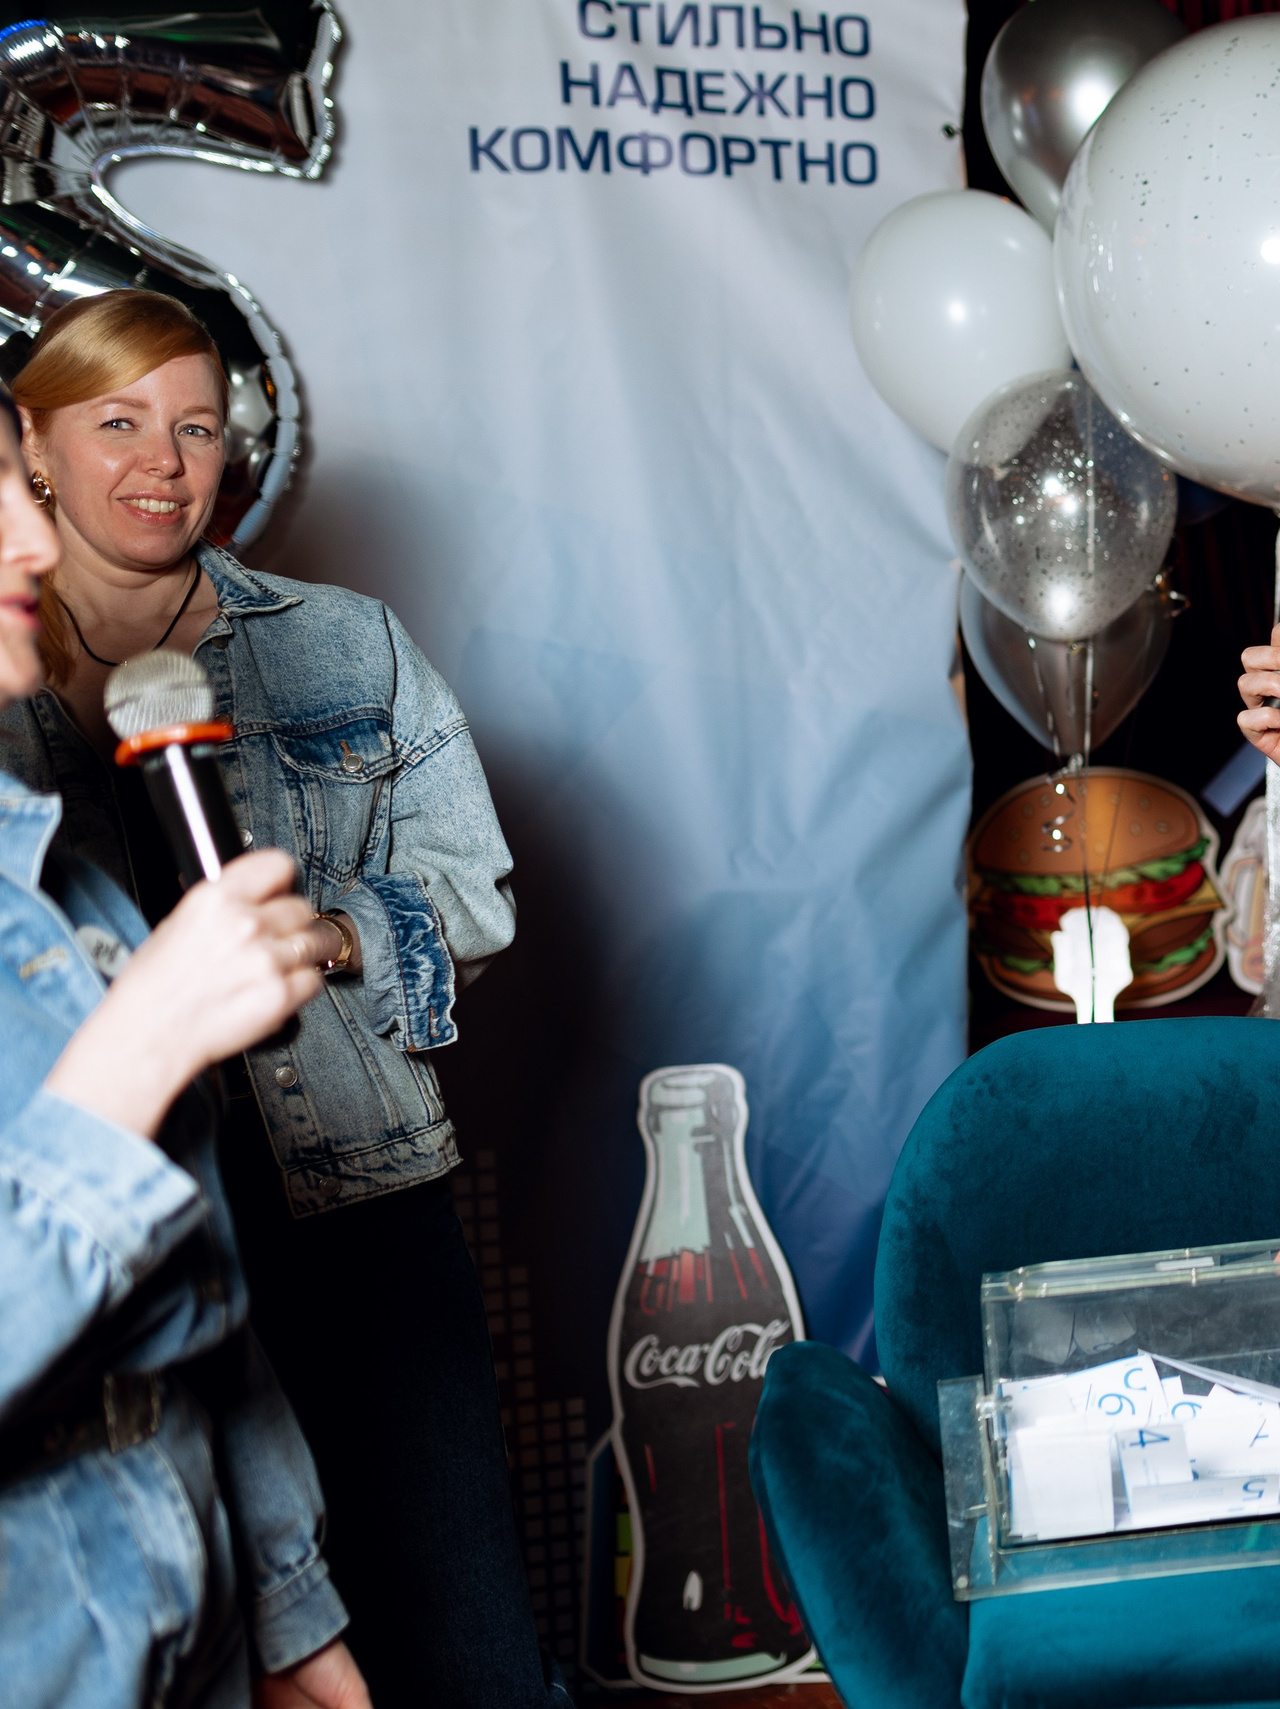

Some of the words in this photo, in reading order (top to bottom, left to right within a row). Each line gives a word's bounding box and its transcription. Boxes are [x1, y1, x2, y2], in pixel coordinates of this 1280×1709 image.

[578, 0, 870, 58] СТИЛЬНО
[559, 60, 876, 121] НАДЕЖНО
[468, 126, 878, 186] КОМФОРТНО
